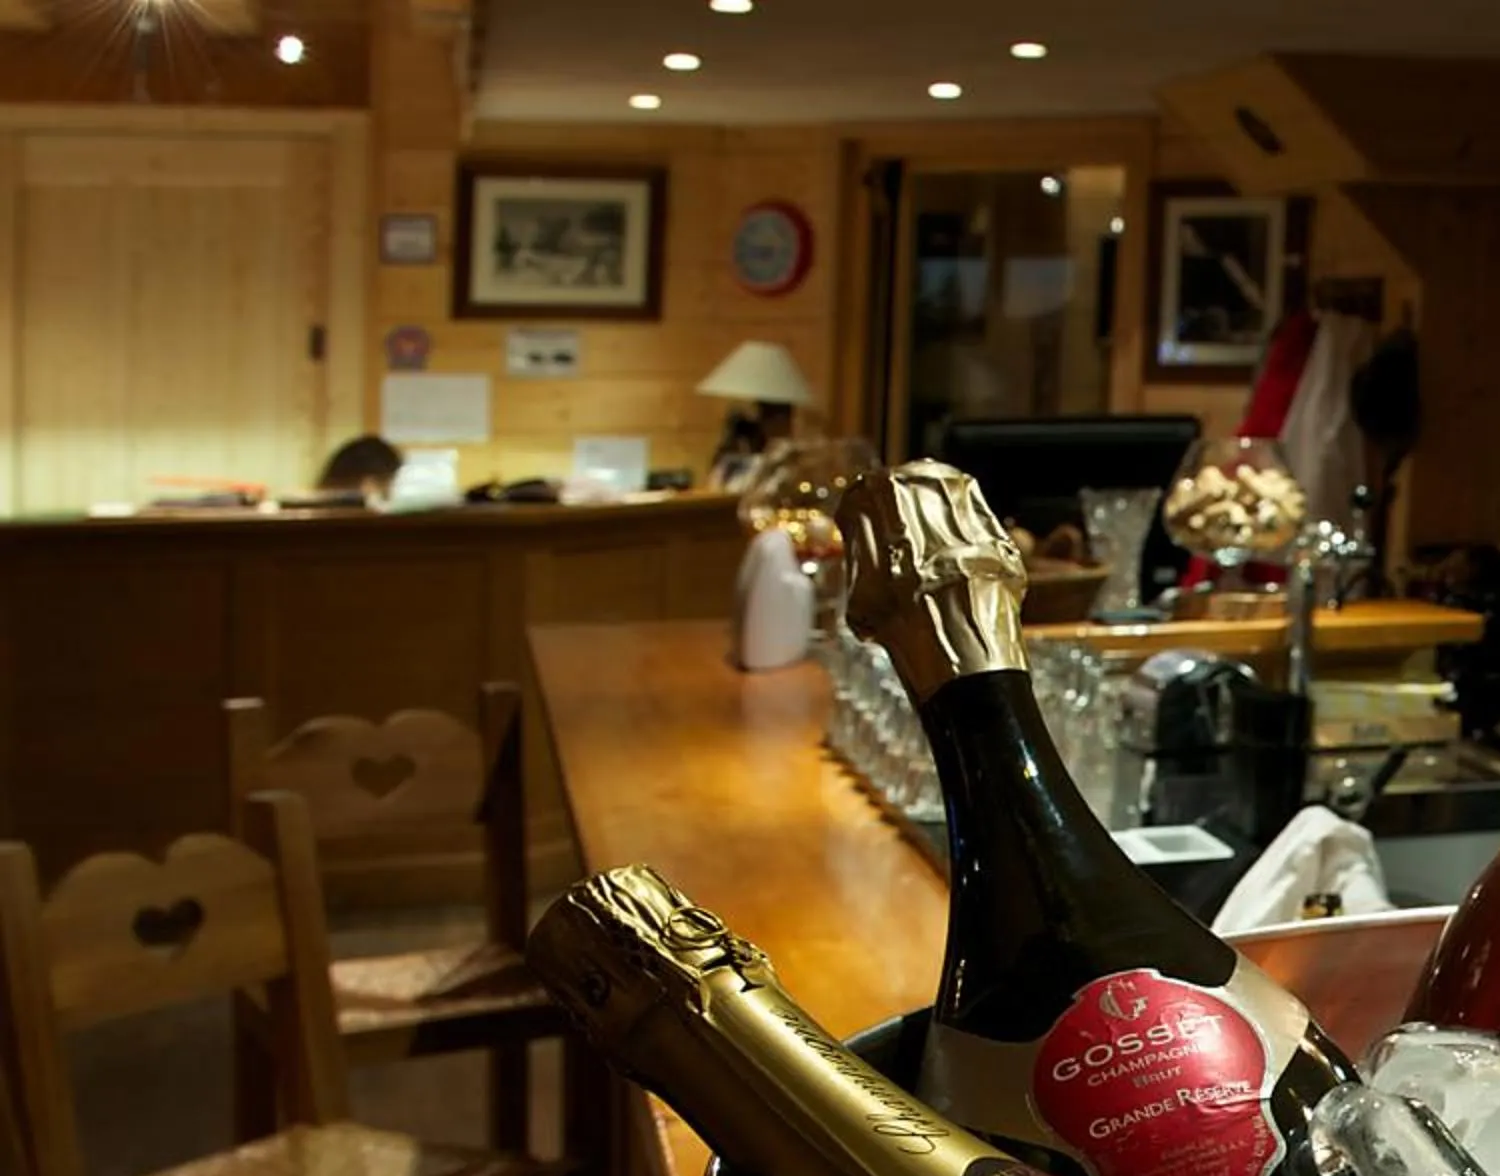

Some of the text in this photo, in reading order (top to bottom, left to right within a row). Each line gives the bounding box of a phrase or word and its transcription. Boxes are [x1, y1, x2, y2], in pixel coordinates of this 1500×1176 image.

[1052, 1014, 1224, 1082] GOSSET
[1087, 1041, 1207, 1087] CHAMPAGN
[1089, 1097, 1175, 1140] GRANDE
